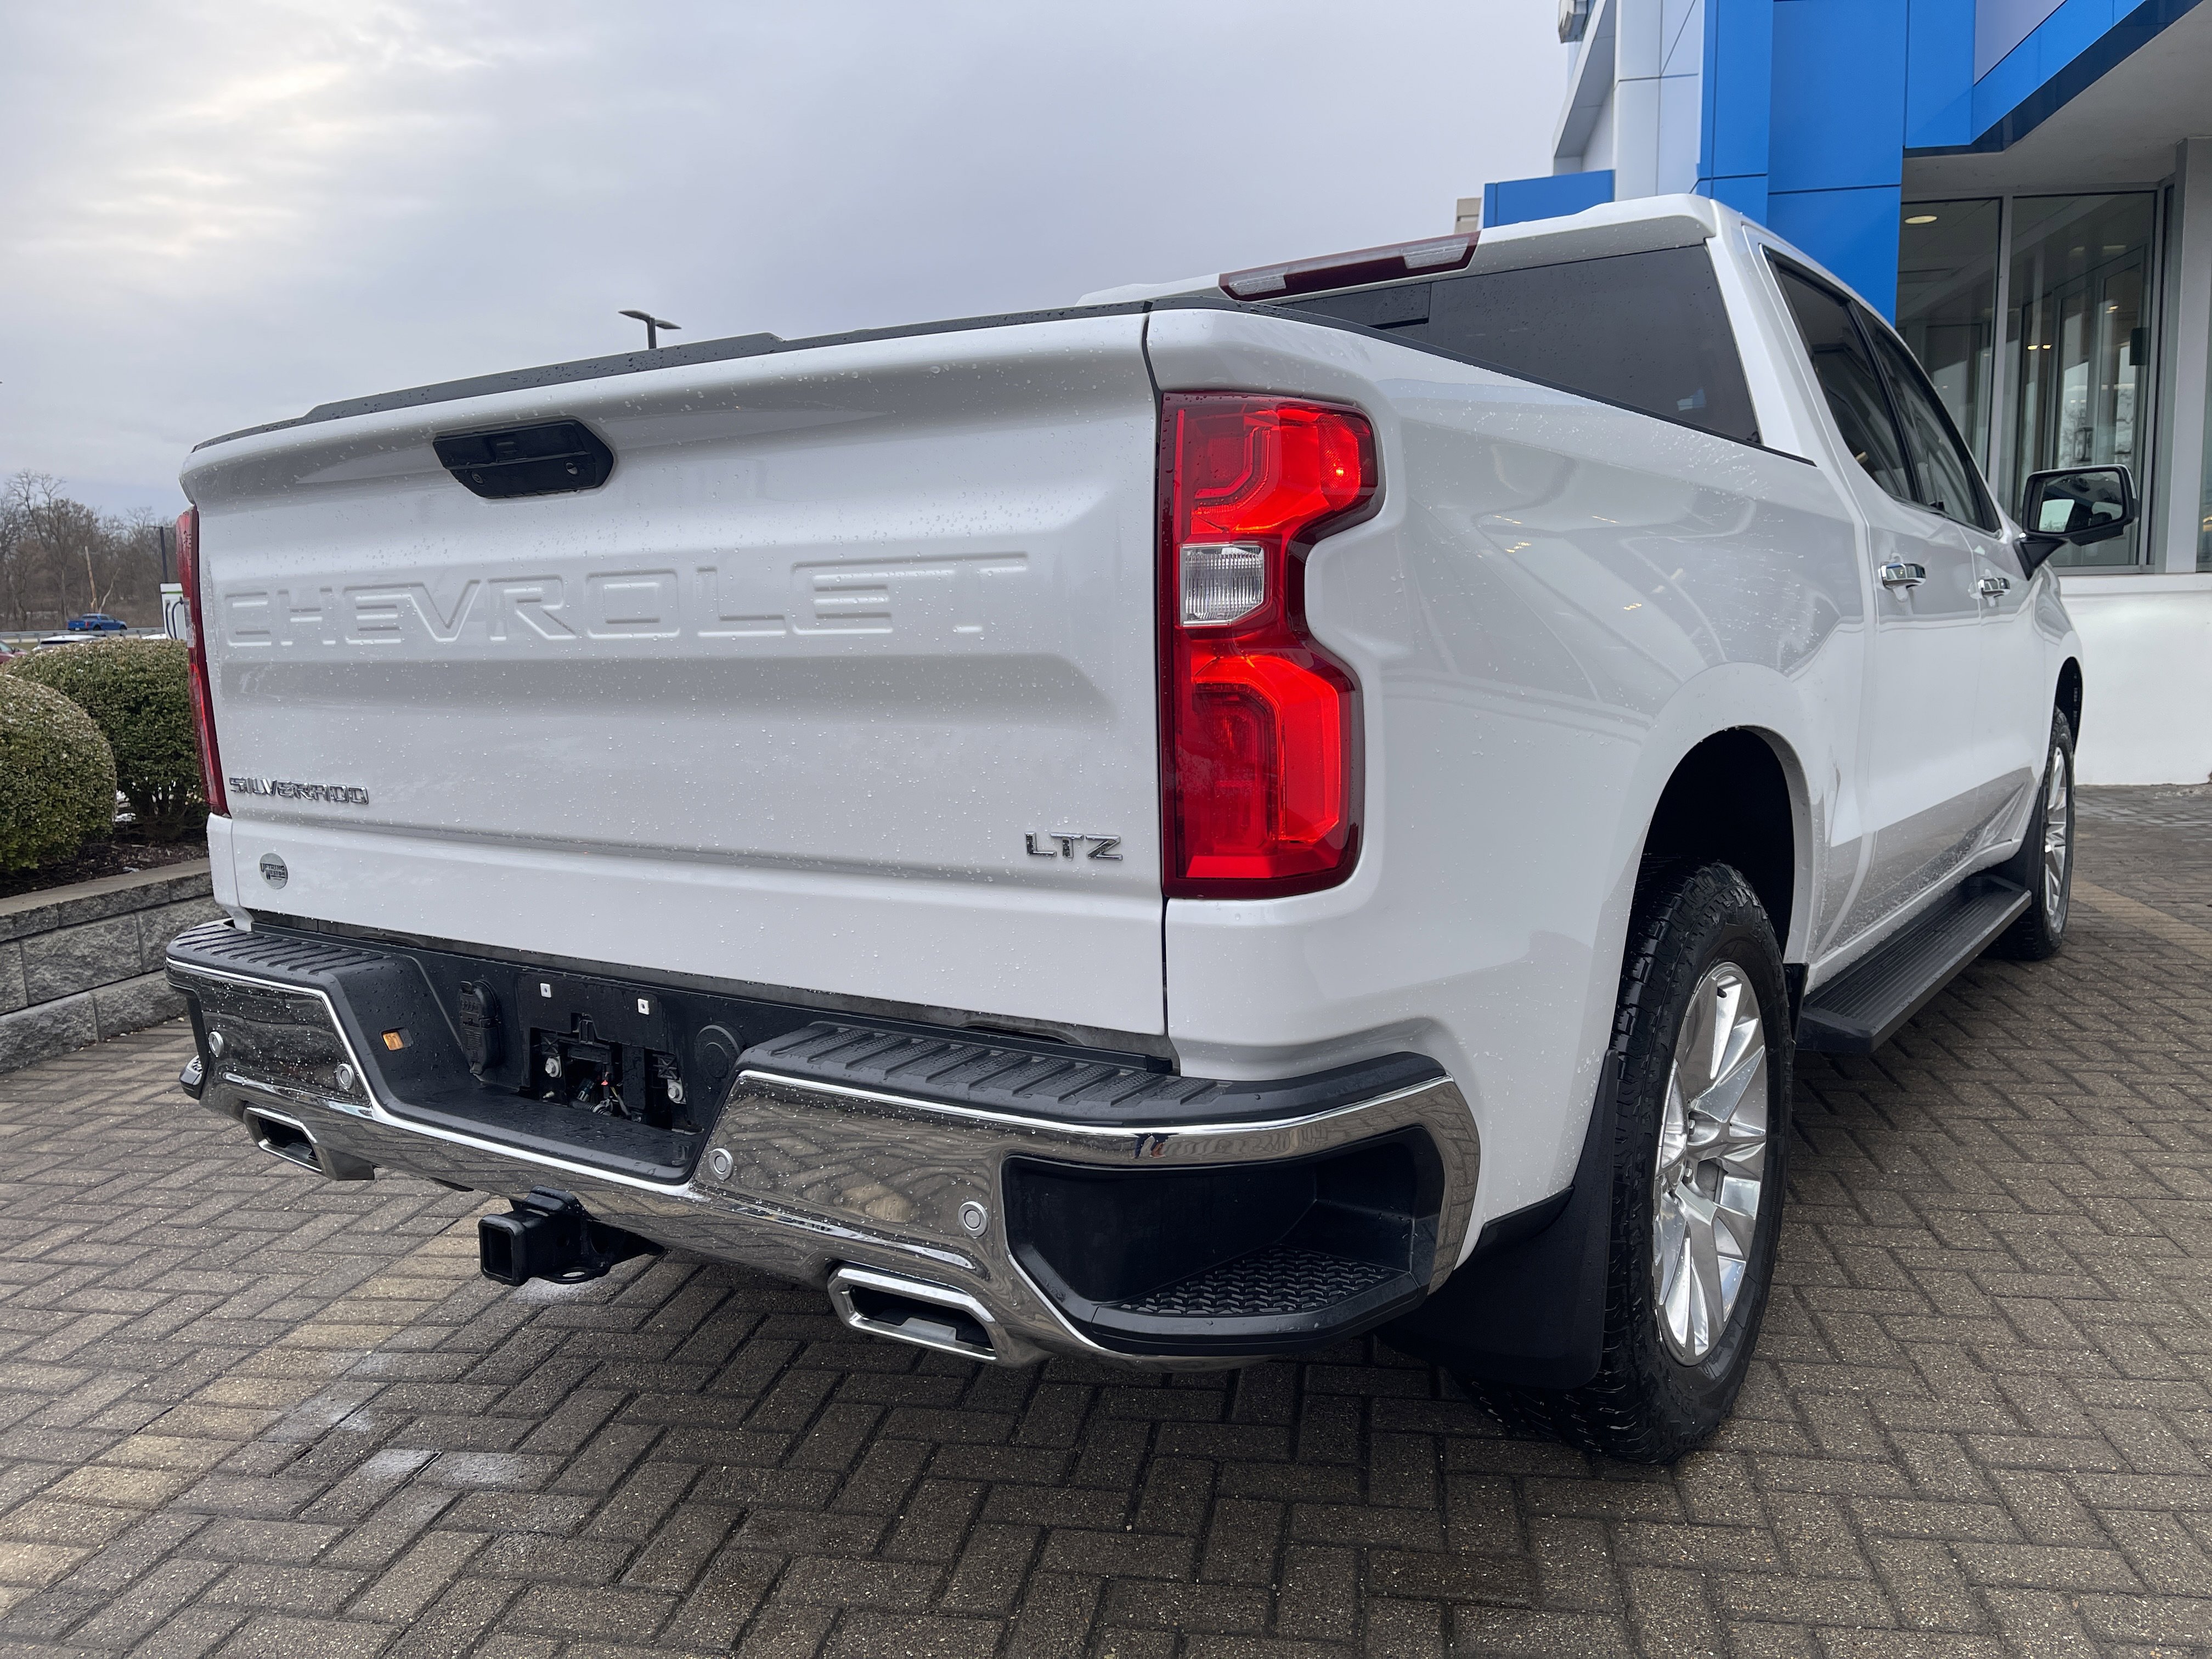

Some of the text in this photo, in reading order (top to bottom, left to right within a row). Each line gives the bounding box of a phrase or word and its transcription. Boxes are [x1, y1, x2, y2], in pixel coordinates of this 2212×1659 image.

[224, 551, 1029, 647] CHEVROLET
[229, 776, 369, 805] SILVERADO
[1024, 831, 1124, 861] LTZ
